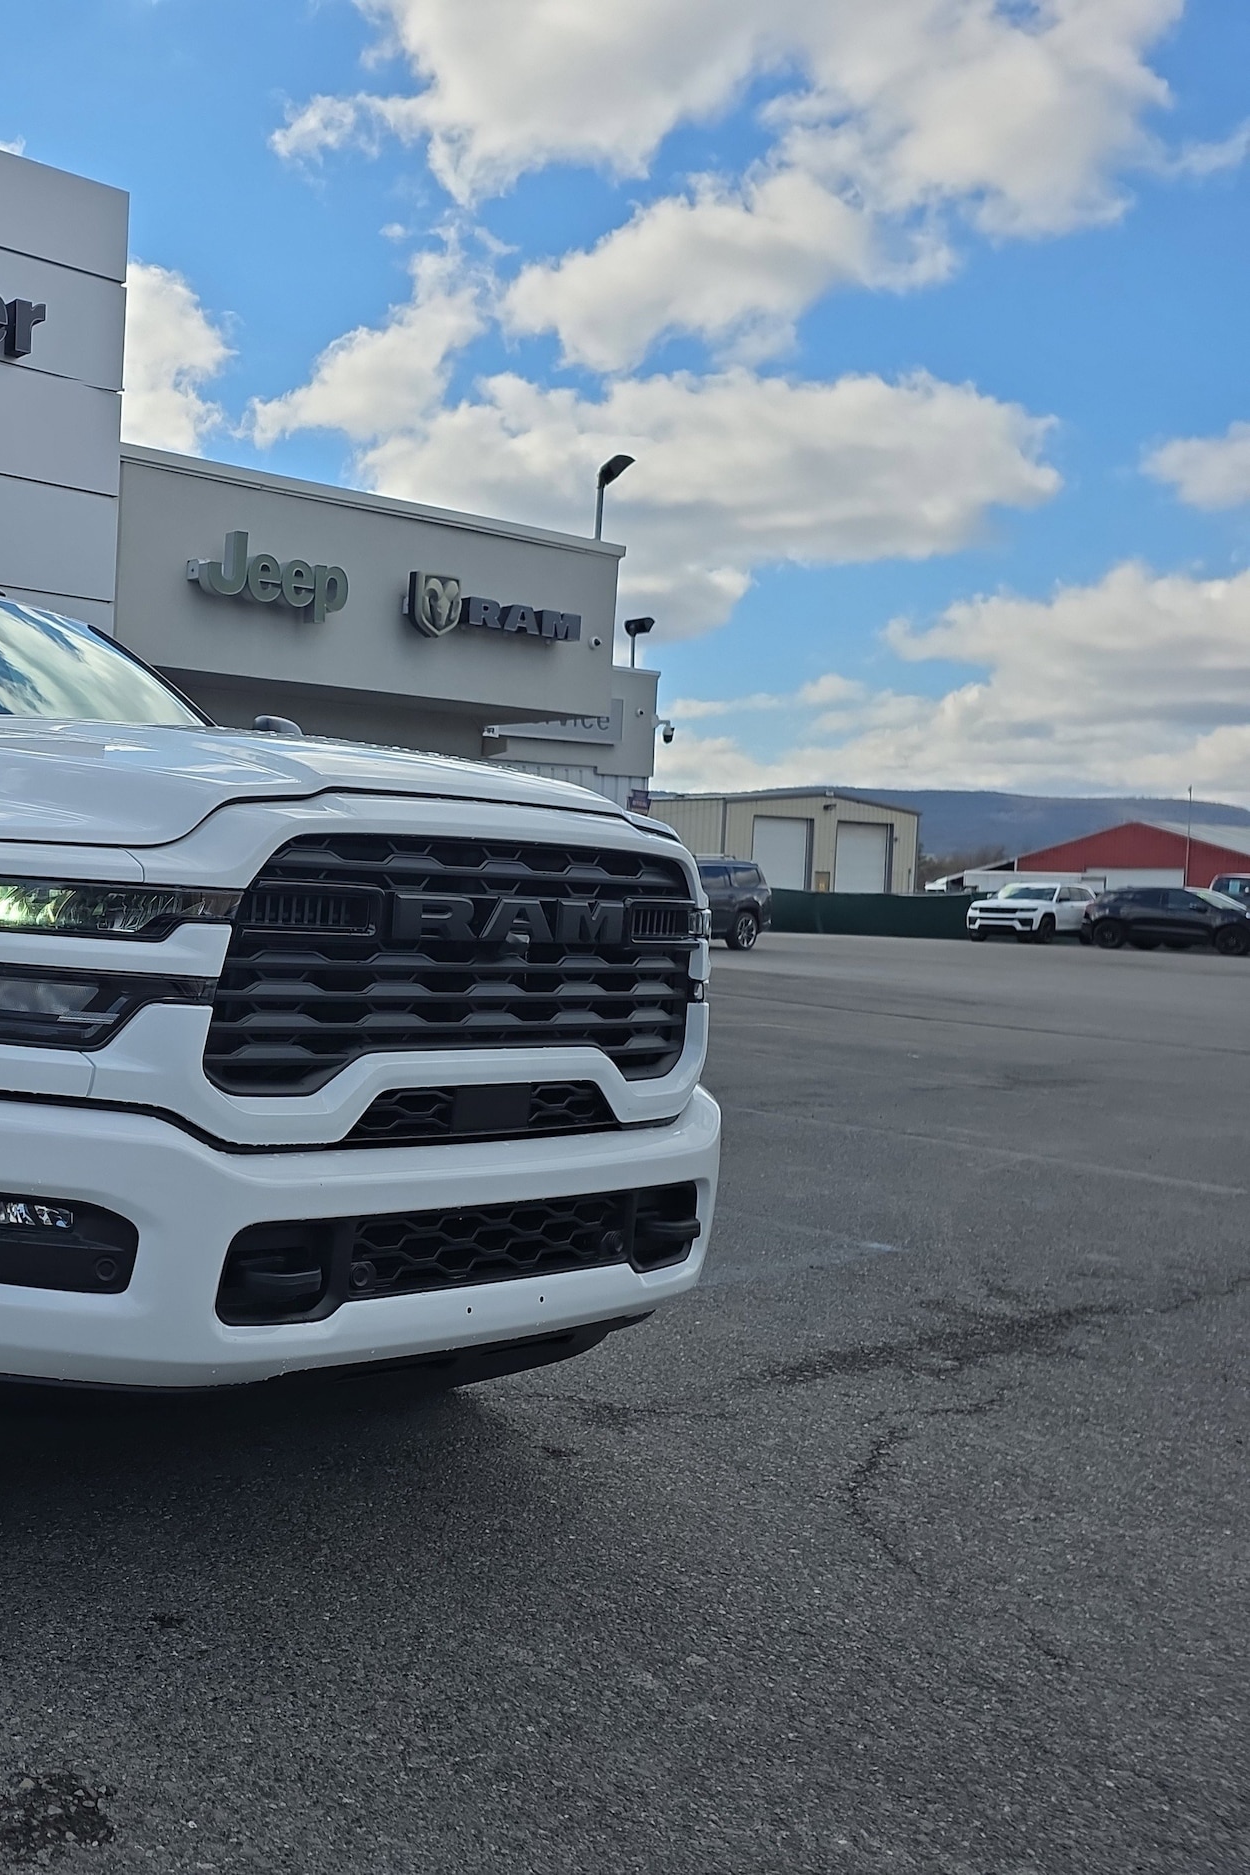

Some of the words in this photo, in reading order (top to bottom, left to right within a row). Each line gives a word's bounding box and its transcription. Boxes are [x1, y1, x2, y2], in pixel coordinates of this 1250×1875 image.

[199, 531, 349, 623] Jeep
[466, 597, 582, 641] RAM
[392, 893, 625, 944] RAM
